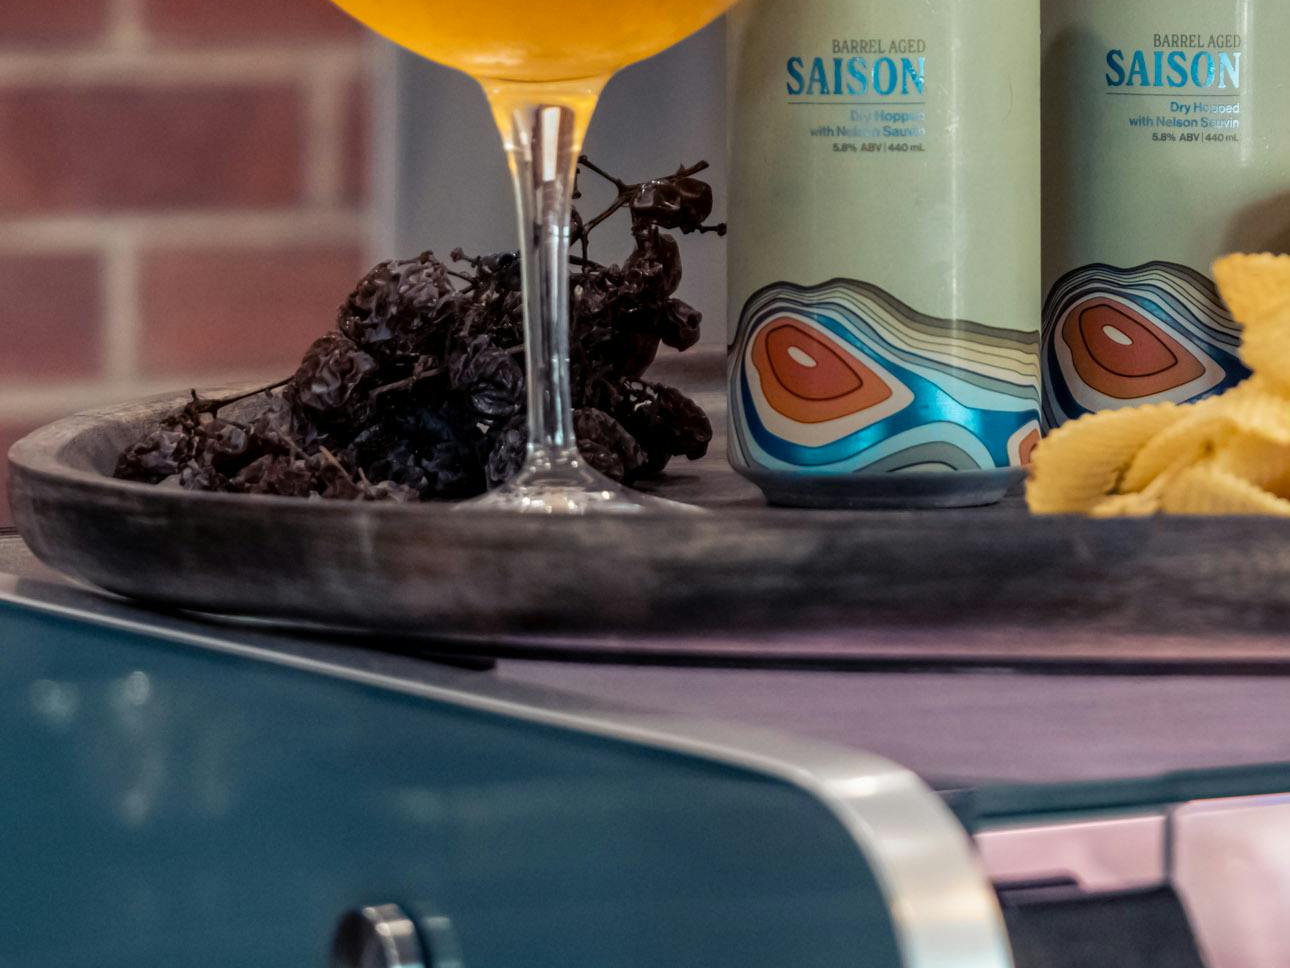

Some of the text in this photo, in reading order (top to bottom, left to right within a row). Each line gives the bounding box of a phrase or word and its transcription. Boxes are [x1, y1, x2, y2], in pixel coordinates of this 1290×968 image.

[832, 38, 926, 54] BARREL AGED
[1153, 33, 1242, 48] BARREL AGED
[786, 56, 926, 96] SAISON
[1105, 48, 1242, 89] SAISON
[1170, 101, 1191, 114] Dry
[1179, 133, 1200, 142] ABV
[1204, 133, 1225, 142] 440
[860, 143, 882, 153] ABV
[887, 143, 909, 153] 440
